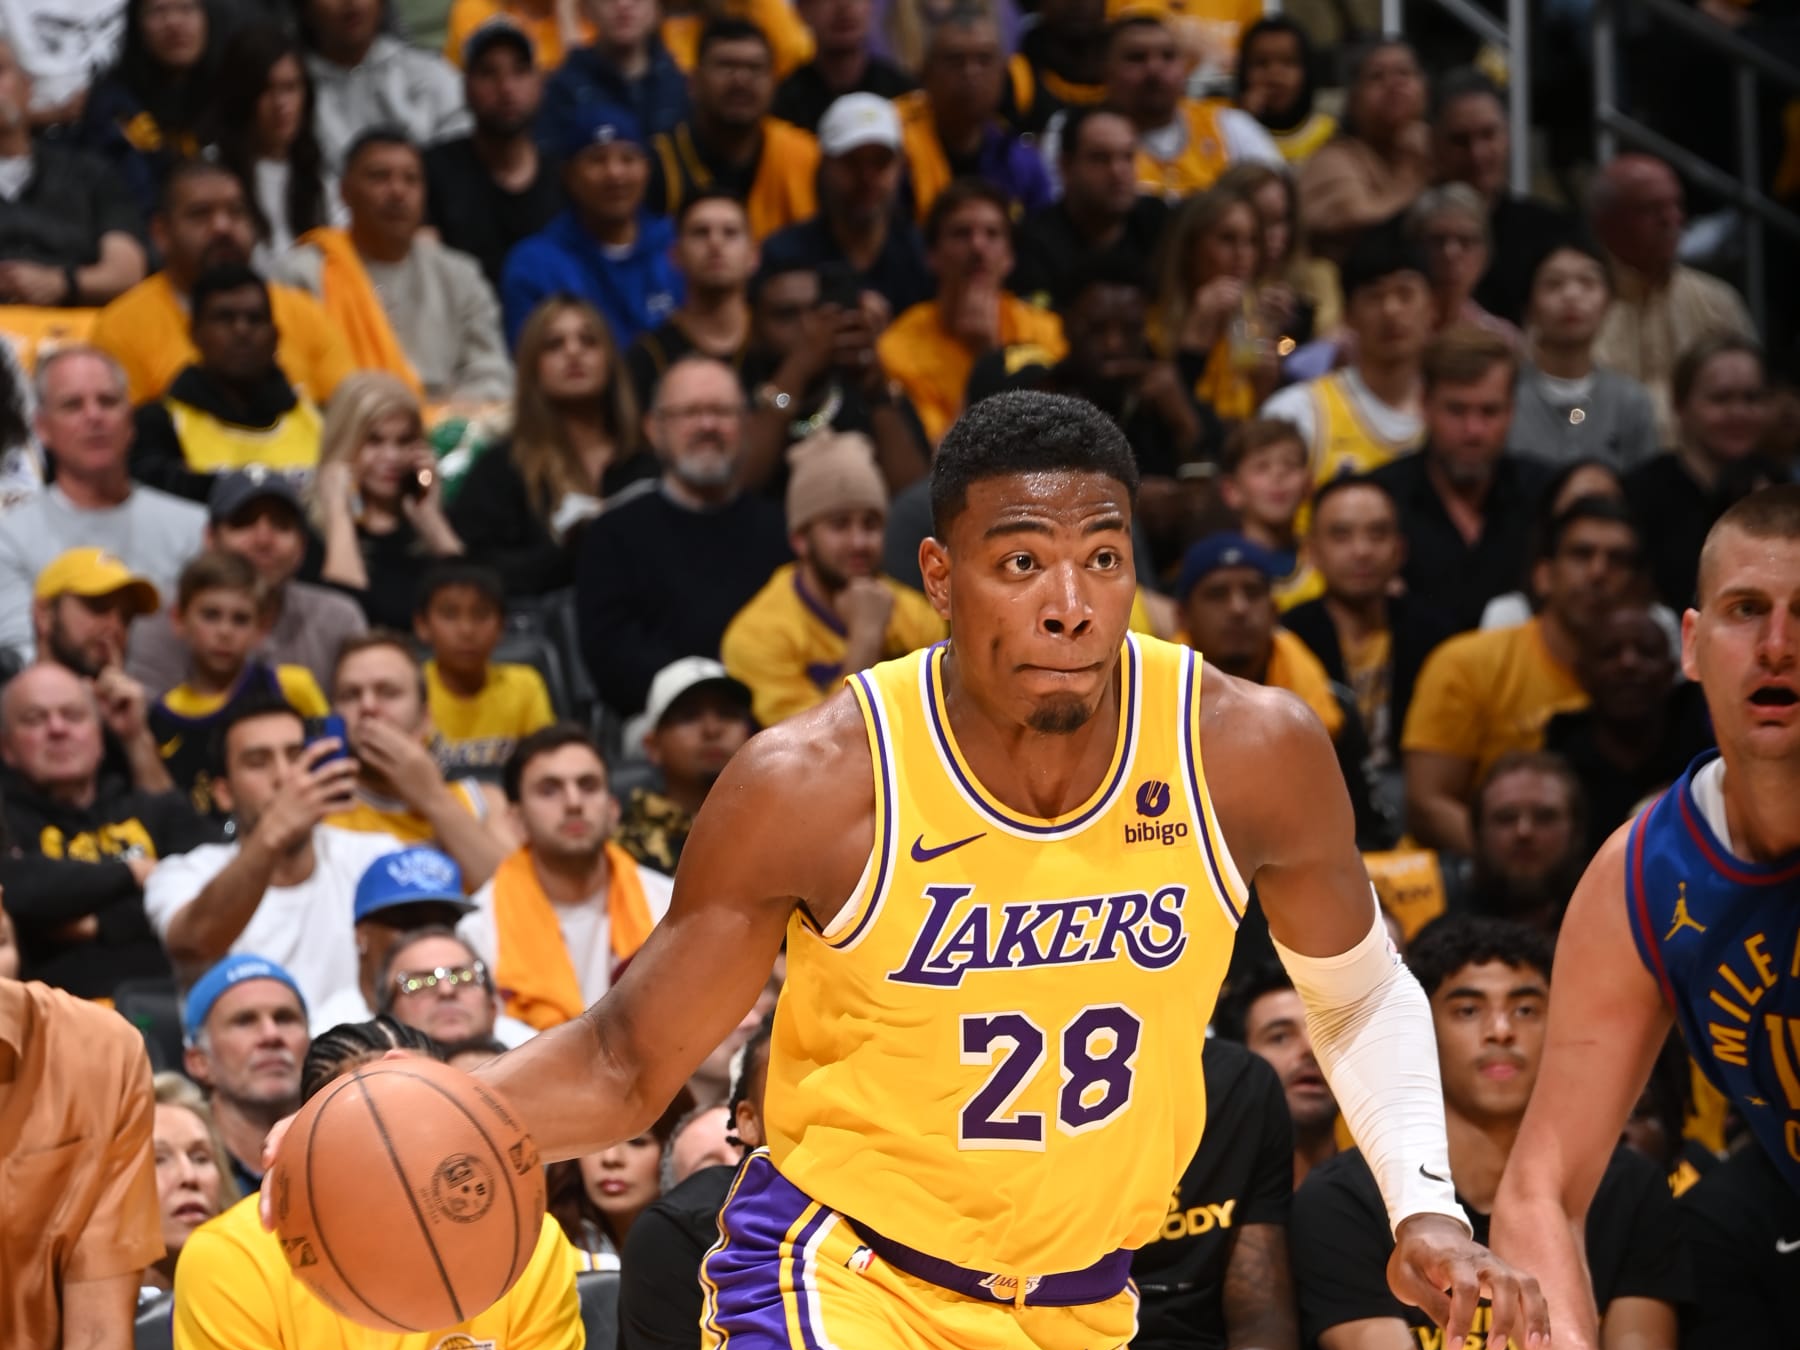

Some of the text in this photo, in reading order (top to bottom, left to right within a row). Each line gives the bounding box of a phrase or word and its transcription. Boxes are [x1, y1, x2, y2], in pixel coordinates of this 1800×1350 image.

[1124, 820, 1188, 846] bibigo
[887, 883, 1191, 989] LAKERS
[1708, 932, 1779, 1067] MILE
[957, 1002, 1144, 1152] 28
[1150, 1199, 1237, 1242] ODY
